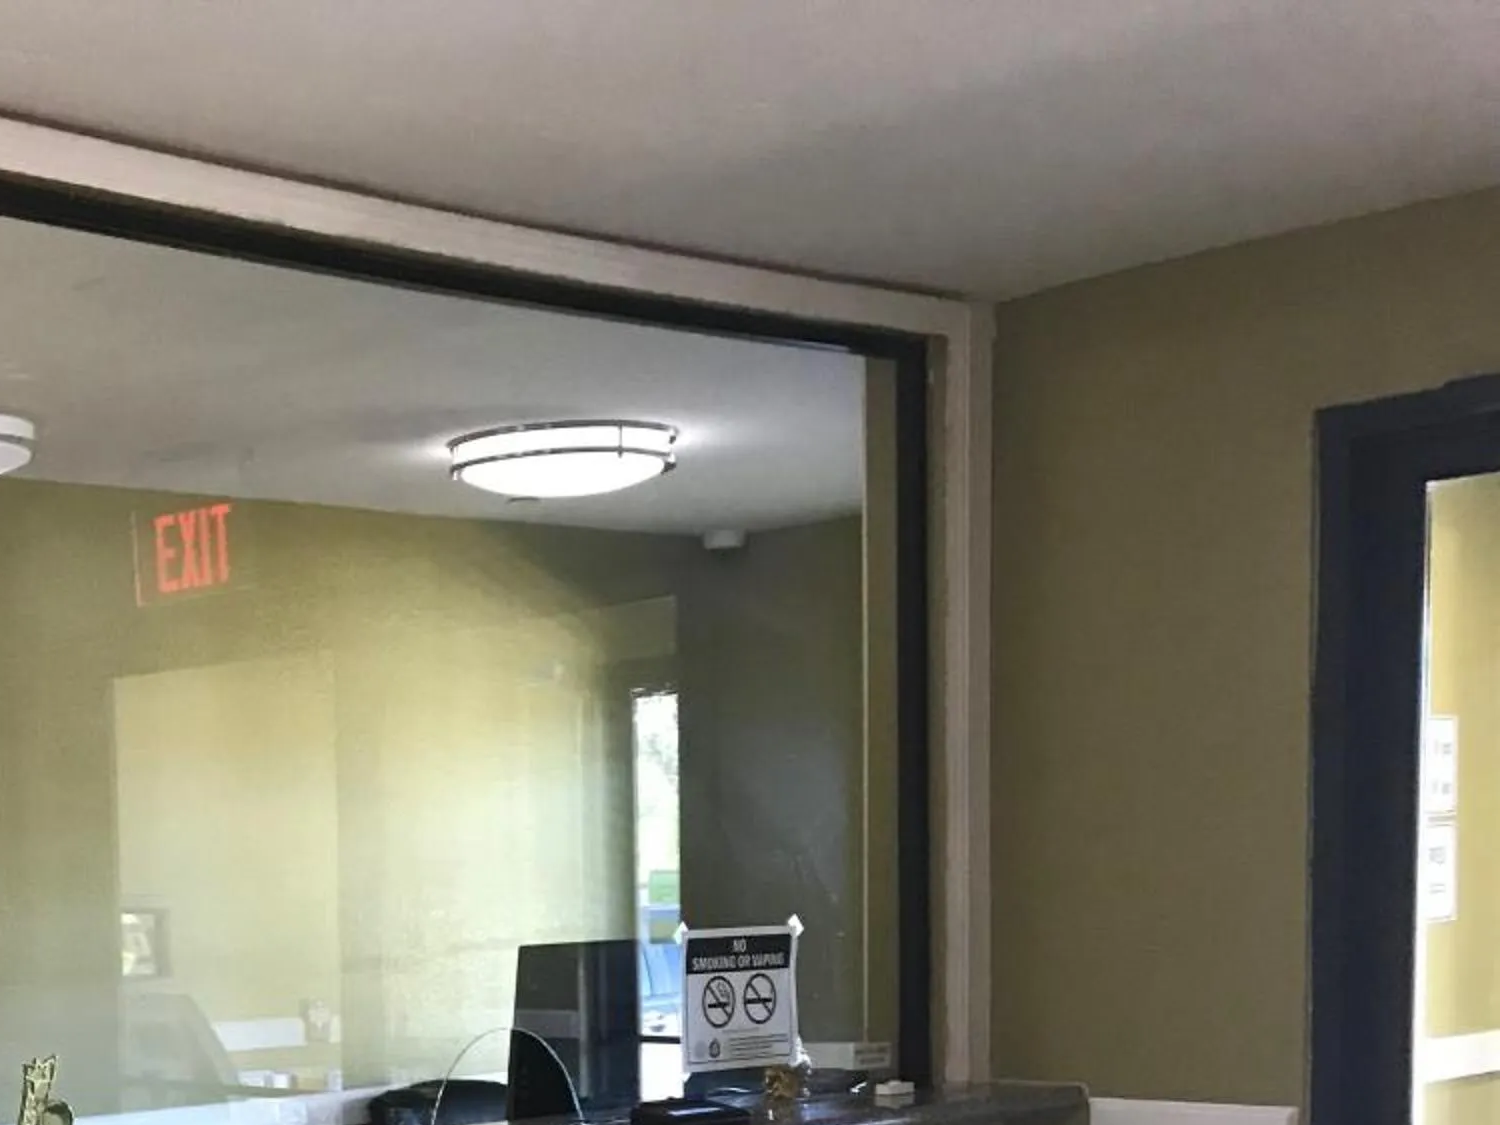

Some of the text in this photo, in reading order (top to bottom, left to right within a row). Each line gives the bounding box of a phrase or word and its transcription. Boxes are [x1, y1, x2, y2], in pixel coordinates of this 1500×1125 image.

[153, 503, 231, 593] EXIT
[732, 938, 747, 953] NO
[691, 951, 785, 971] SMOKING OR VAPING
